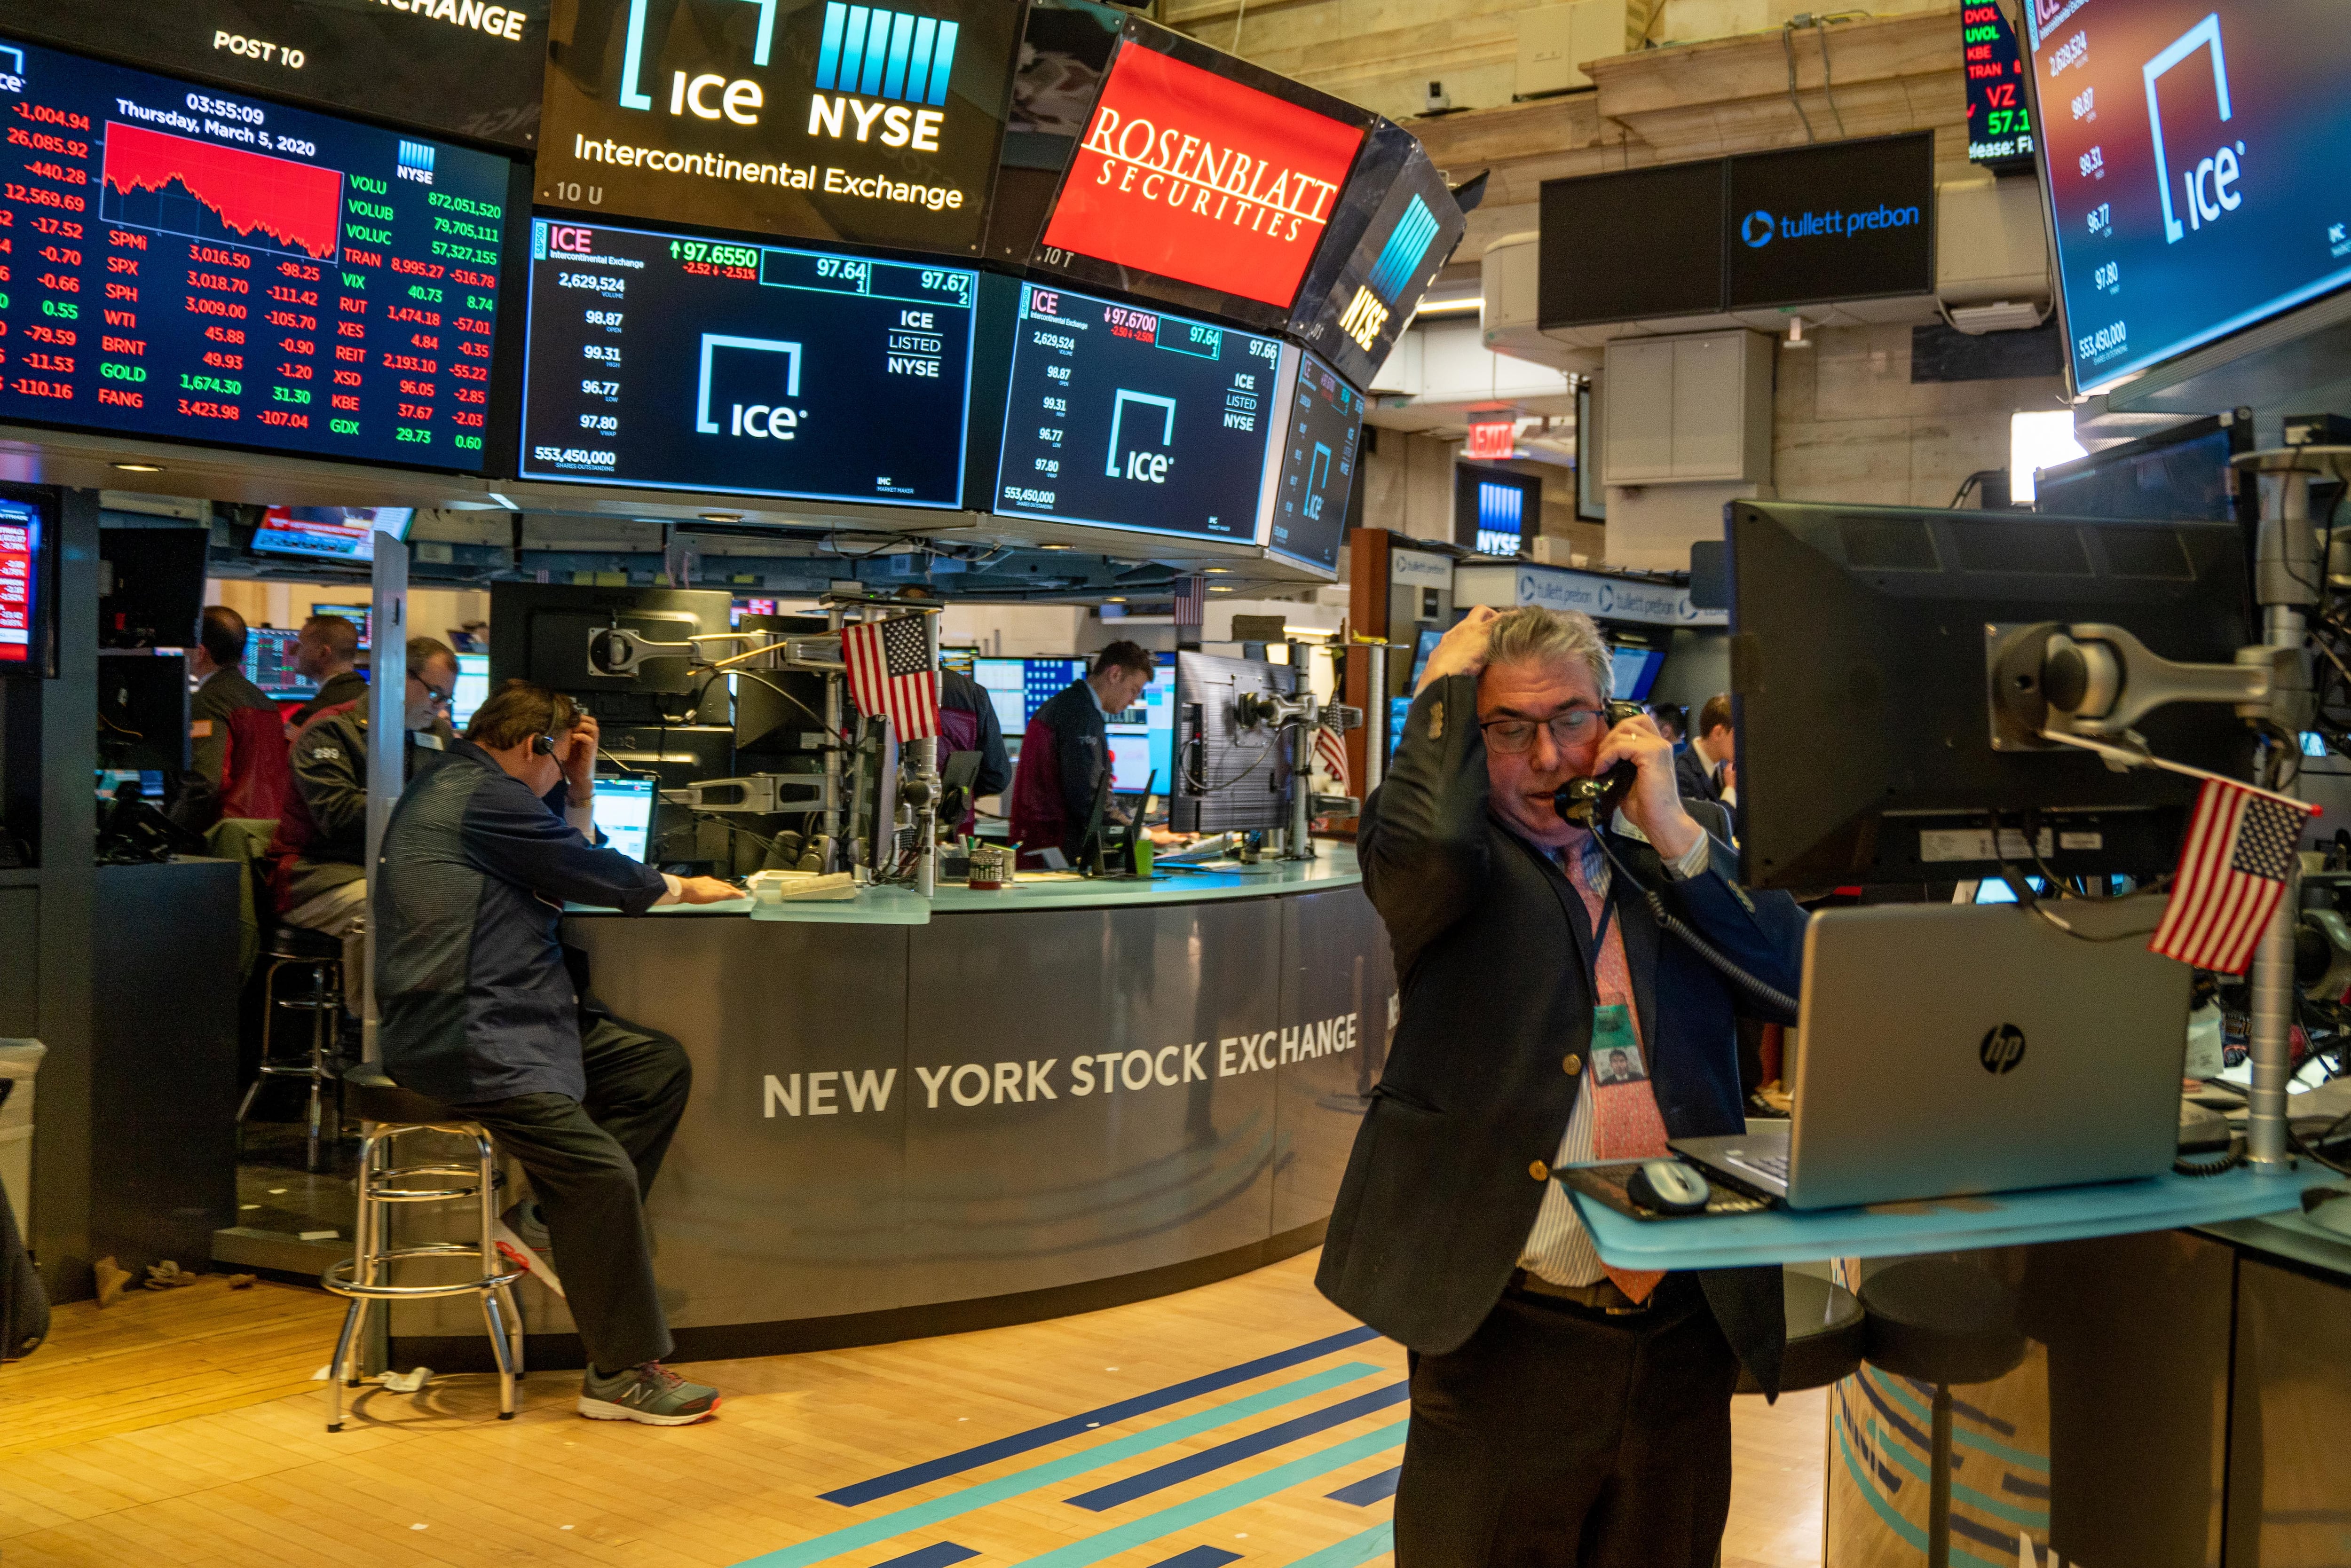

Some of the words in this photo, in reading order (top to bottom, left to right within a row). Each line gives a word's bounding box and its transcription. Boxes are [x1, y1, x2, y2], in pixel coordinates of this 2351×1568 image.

[1964, 7, 1998, 25] DVOL
[1965, 25, 2000, 43] UVOL
[214, 31, 276, 63] POST
[281, 47, 305, 69] 10
[1967, 45, 1992, 61] KBE
[2049, 30, 2087, 77] 2,629,524
[1968, 63, 2002, 79] TRAN
[1986, 83, 2016, 108] VZ
[2071, 86, 2093, 120] 98.87
[12, 102, 90, 131] -1,004.94
[186, 93, 264, 126] 03:55:09
[116, 98, 200, 134] Thursday,
[204, 118, 254, 144] March
[258, 131, 273, 150] 5,
[276, 136, 316, 157] 2020
[807, 94, 944, 152] NYSE
[7, 127, 88, 158] 26,085.92
[24, 161, 87, 185] -440.28
[575, 134, 816, 190] Intercontinental
[823, 169, 963, 210] Exchange
[1084, 106, 1337, 223] ROSENBLATT
[2079, 145, 2103, 177] 99.31
[397, 165, 433, 185] NYSE
[4, 183, 85, 212] 12,569.69
[350, 174, 387, 195] VOLU
[428, 191, 501, 219] 872,051,520
[556, 182, 581, 202] 10
[587, 187, 603, 205] U
[1097, 158, 1302, 242] SECURITIES
[31, 217, 83, 236] -17.52
[348, 199, 394, 221] VOLUB
[434, 217, 498, 243] 79,705,111
[1781, 211, 1843, 239] tullett
[1846, 204, 1919, 239] prebon
[2087, 203, 2110, 234] 96.77
[346, 223, 392, 245] VOLUC
[432, 240, 497, 265] 57,327,155
[551, 226, 592, 253] ICE
[39, 247, 82, 266] -0.70
[109, 230, 147, 251] SPMi
[189, 244, 250, 269] 3,016.50
[276, 261, 320, 282] -98.25
[344, 247, 382, 268] TRAN
[391, 257, 445, 279] 8,995.27
[450, 269, 496, 289] -516.78
[550, 250, 607, 265] Intercontinental
[608, 256, 644, 268] Exchange
[683, 243, 757, 268] 97.6550
[1043, 246, 1061, 265] 10
[1064, 251, 1074, 268] T
[37, 273, 79, 292] -0.66
[107, 256, 138, 276] SPX
[187, 270, 248, 294] 3,018.70
[266, 286, 318, 307] -111.42
[558, 272, 625, 293] 2,629,524
[683, 263, 710, 275] -2.52
[722, 269, 756, 281] -2.51%
[817, 258, 866, 281] 97.64
[921, 270, 969, 292] 97.67
[2095, 261, 2118, 291] 97.80
[342, 272, 365, 290] VIX
[408, 285, 442, 303] 40.73
[467, 295, 493, 312] 8.74
[856, 280, 865, 293] 1
[959, 292, 968, 304] 2
[1032, 289, 1057, 315] ICE
[42, 299, 78, 319] 0.55
[105, 283, 138, 302] SPH
[185, 297, 246, 320] 3,009.00
[265, 311, 316, 330] -105.70
[339, 296, 368, 314] RUT
[387, 306, 441, 327] 1,474.18
[452, 317, 491, 335] -57.01
[585, 310, 623, 326] 98.87
[901, 309, 934, 329] ICE
[1339, 284, 1389, 352] NYSE
[103, 309, 135, 328] WTI
[205, 326, 245, 345] 45.88
[279, 339, 314, 355] -0.90
[1031, 311, 1065, 324] Intercontinental
[1066, 318, 1088, 330] Exchange
[1112, 308, 1156, 332] 97.6700
[24, 325, 77, 346] -79.59
[337, 321, 365, 338] XES
[411, 334, 439, 350] 4.84
[458, 341, 489, 358] -0.35
[889, 335, 941, 352] LISTED
[1033, 331, 1074, 350] 2,629,524
[1190, 326, 1219, 345] 97.64
[1249, 339, 1277, 359] 97.66
[2078, 321, 2126, 360] 553,450,000
[22, 354, 75, 373] -11.53
[102, 336, 146, 356] BRNT
[203, 352, 243, 370] 49.93
[277, 363, 312, 380] -1.20
[336, 345, 367, 363] REIT
[383, 353, 437, 374] 2,193.10
[449, 364, 487, 381] -55.22
[584, 345, 621, 362] 99.31
[888, 357, 939, 377] NYSE
[1047, 365, 1071, 380] 98.87
[10, 379, 73, 400] -110.16
[100, 362, 146, 382] GOLD
[180, 374, 241, 395] 1,674.30
[272, 386, 310, 404] 31.30
[333, 370, 362, 386] XSD
[400, 379, 435, 397] 96.05
[454, 388, 486, 404] -2.85
[582, 380, 619, 395] 96.77
[1234, 372, 1255, 390] ICE
[98, 388, 143, 409] FANG
[178, 399, 239, 421] 3,423.98
[257, 411, 308, 429] -107.04
[331, 394, 360, 411] KBE
[398, 403, 434, 420] 37.67
[452, 411, 484, 427] -2.03
[1043, 396, 1066, 411] 99.31
[1226, 394, 1256, 410] LISTED
[330, 418, 360, 435] GDX
[396, 427, 431, 444] 29.73
[455, 434, 481, 450] 0.60
[580, 414, 618, 430] 97.80
[1039, 427, 1063, 441] 96.77
[1223, 413, 1254, 432] NYSE
[1475, 425, 1508, 454] EXIT
[535, 446, 615, 465] 553,450,000
[1035, 458, 1058, 473] 97.80
[877, 477, 891, 486] IMC
[1004, 486, 1055, 504] 553,450,000
[1476, 529, 1521, 556] NYSE
[764, 1068, 897, 1117] NEW
[915, 1059, 1057, 1108] YORK
[1070, 1042, 1208, 1095] STOCK
[1219, 1013, 1357, 1077] EXCHANGE
